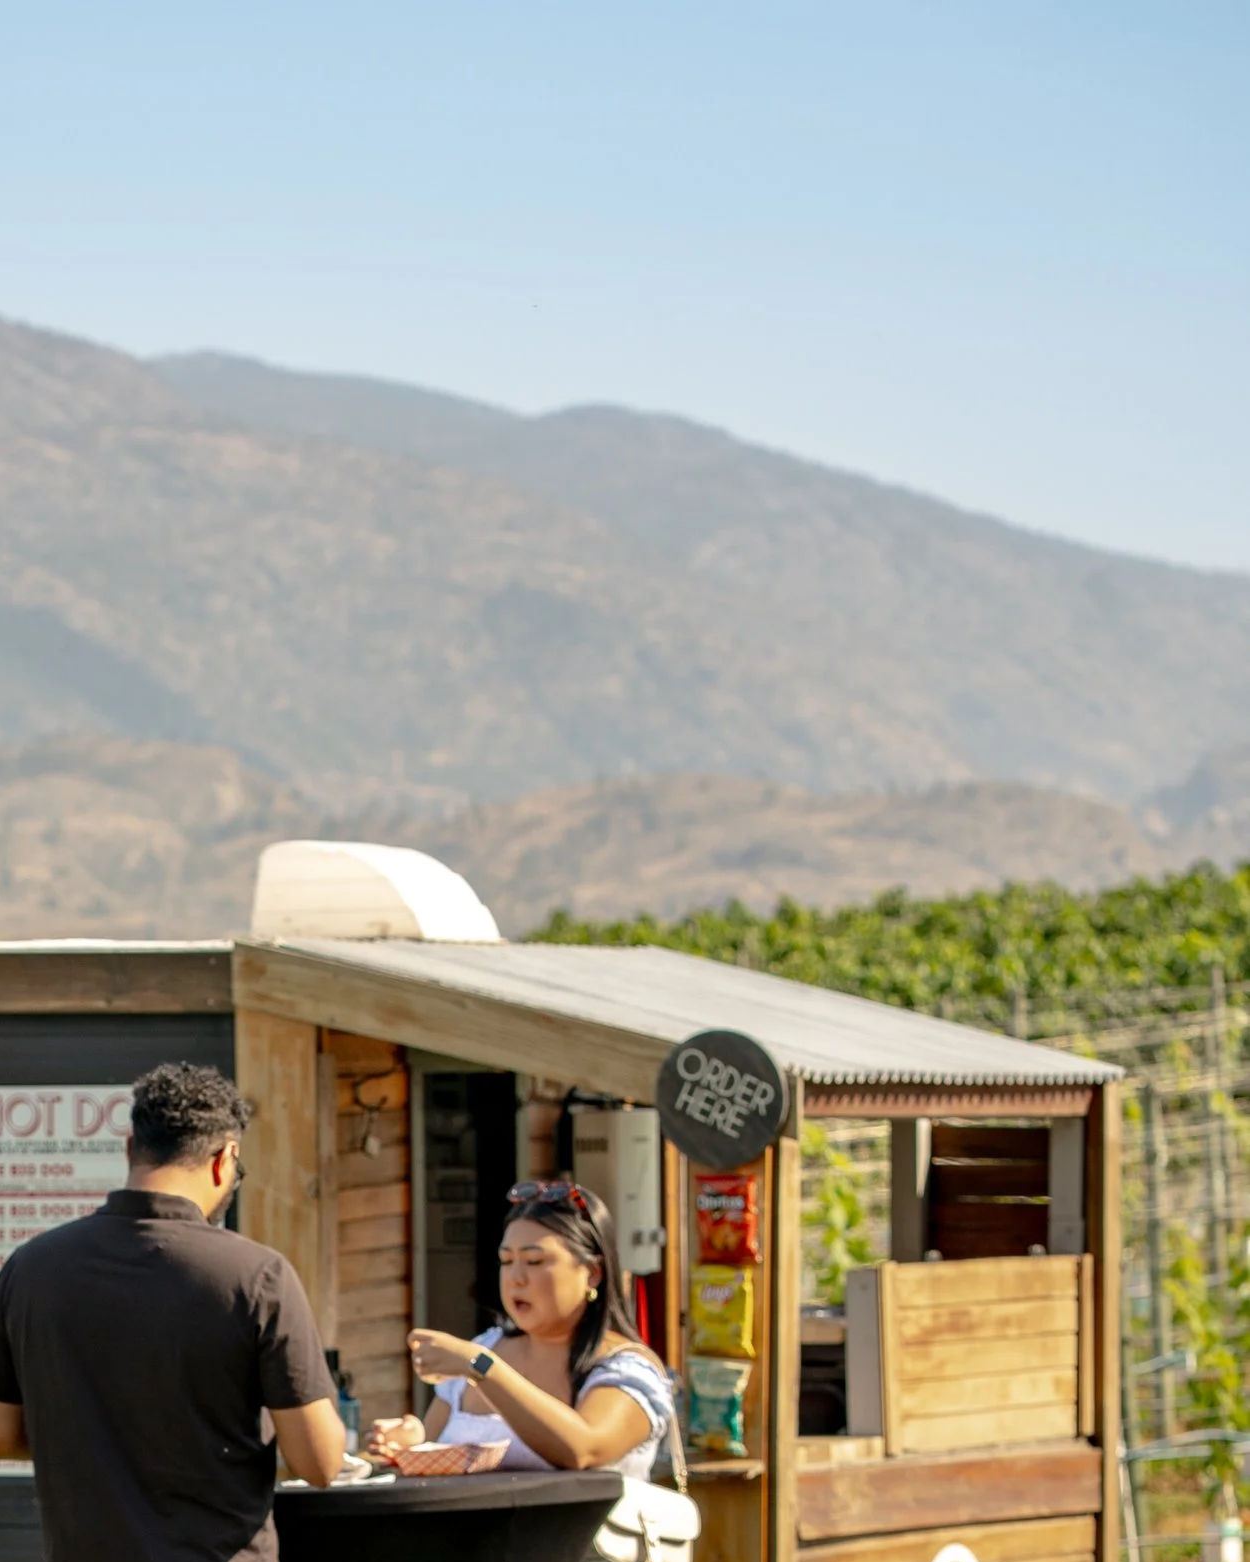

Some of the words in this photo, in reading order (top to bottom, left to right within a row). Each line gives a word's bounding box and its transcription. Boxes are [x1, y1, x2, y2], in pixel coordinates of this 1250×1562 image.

[674, 1080, 749, 1139] HERE
[676, 1048, 775, 1116] ORDER
[73, 1091, 134, 1137] DO
